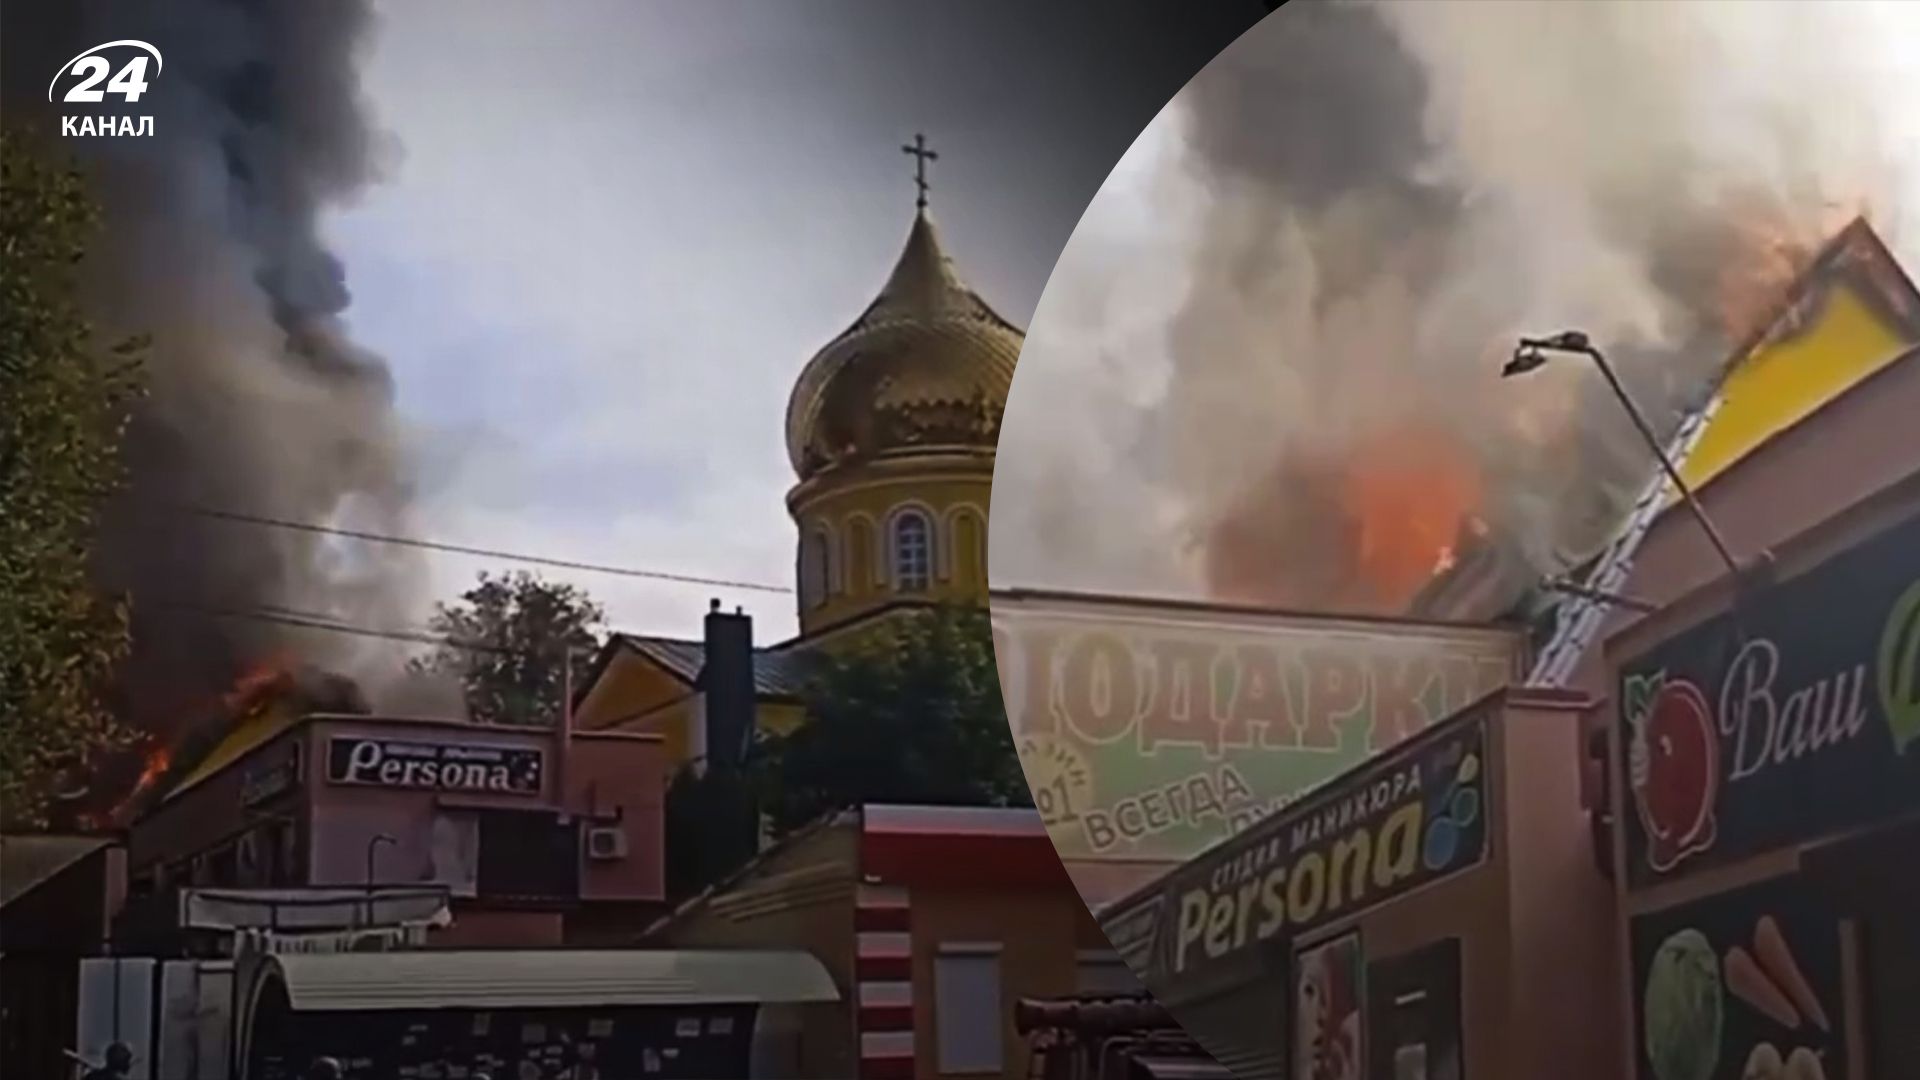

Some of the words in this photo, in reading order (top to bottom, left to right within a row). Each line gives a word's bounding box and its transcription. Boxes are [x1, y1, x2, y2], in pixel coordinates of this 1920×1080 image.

[345, 741, 511, 791] Persona
[1719, 638, 1867, 782] Ваш
[1085, 766, 1249, 850] ВСЕГДА
[1175, 798, 1425, 973] Persona
